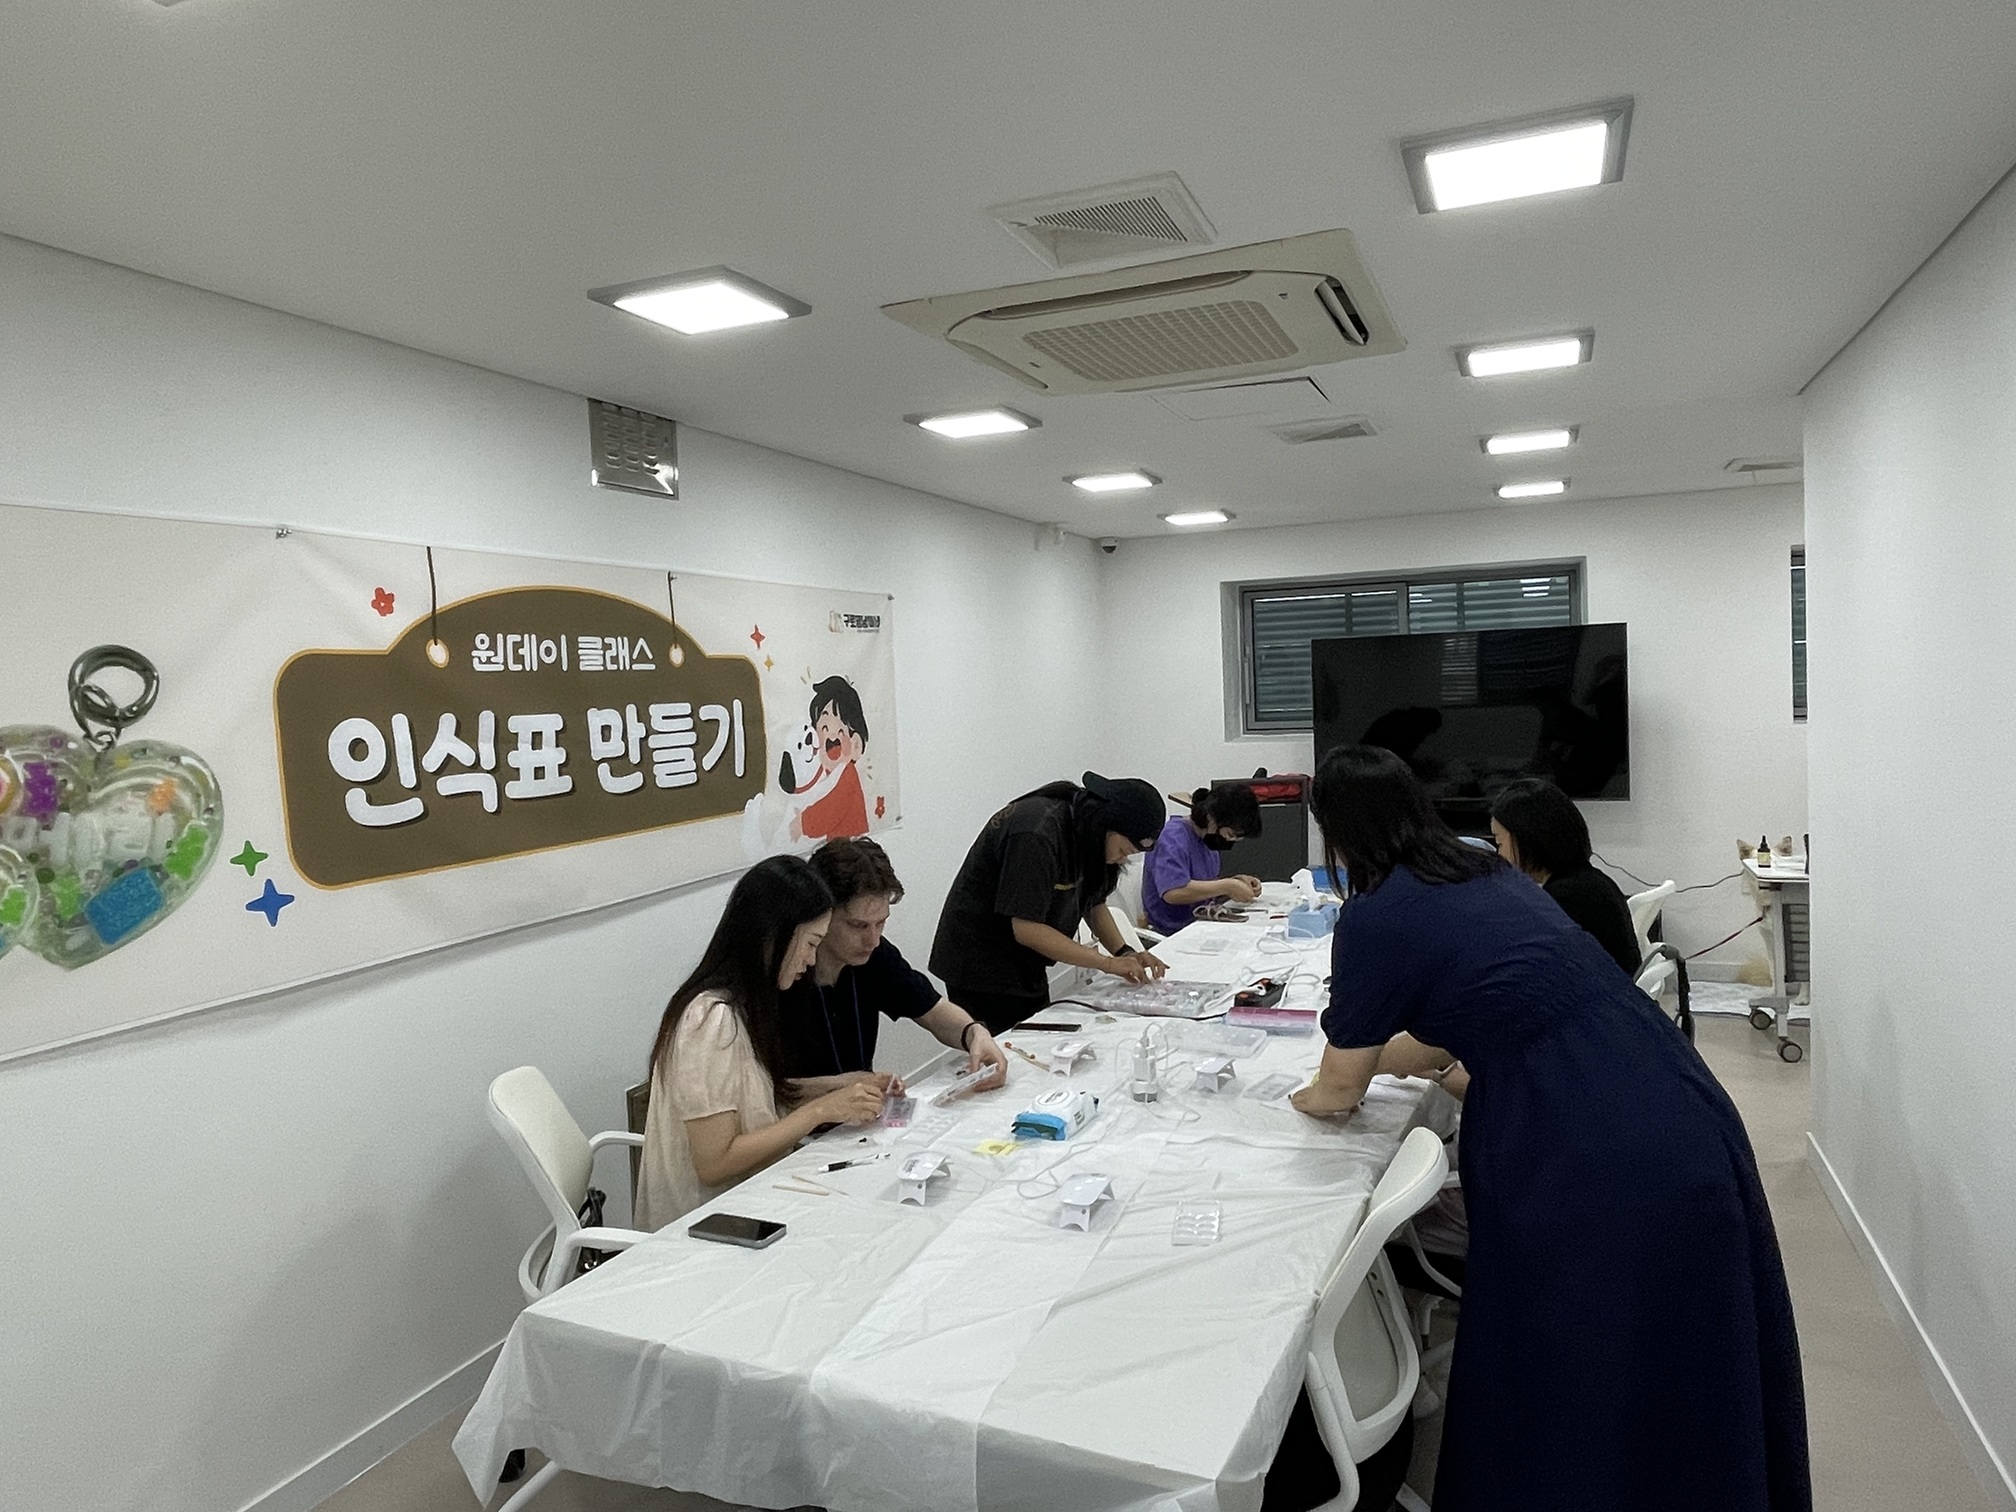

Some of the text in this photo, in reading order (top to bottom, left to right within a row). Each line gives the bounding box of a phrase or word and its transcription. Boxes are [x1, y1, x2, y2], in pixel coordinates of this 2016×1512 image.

[471, 632, 656, 672] 원데이 클래스
[327, 698, 746, 827] 인식표 만들기
